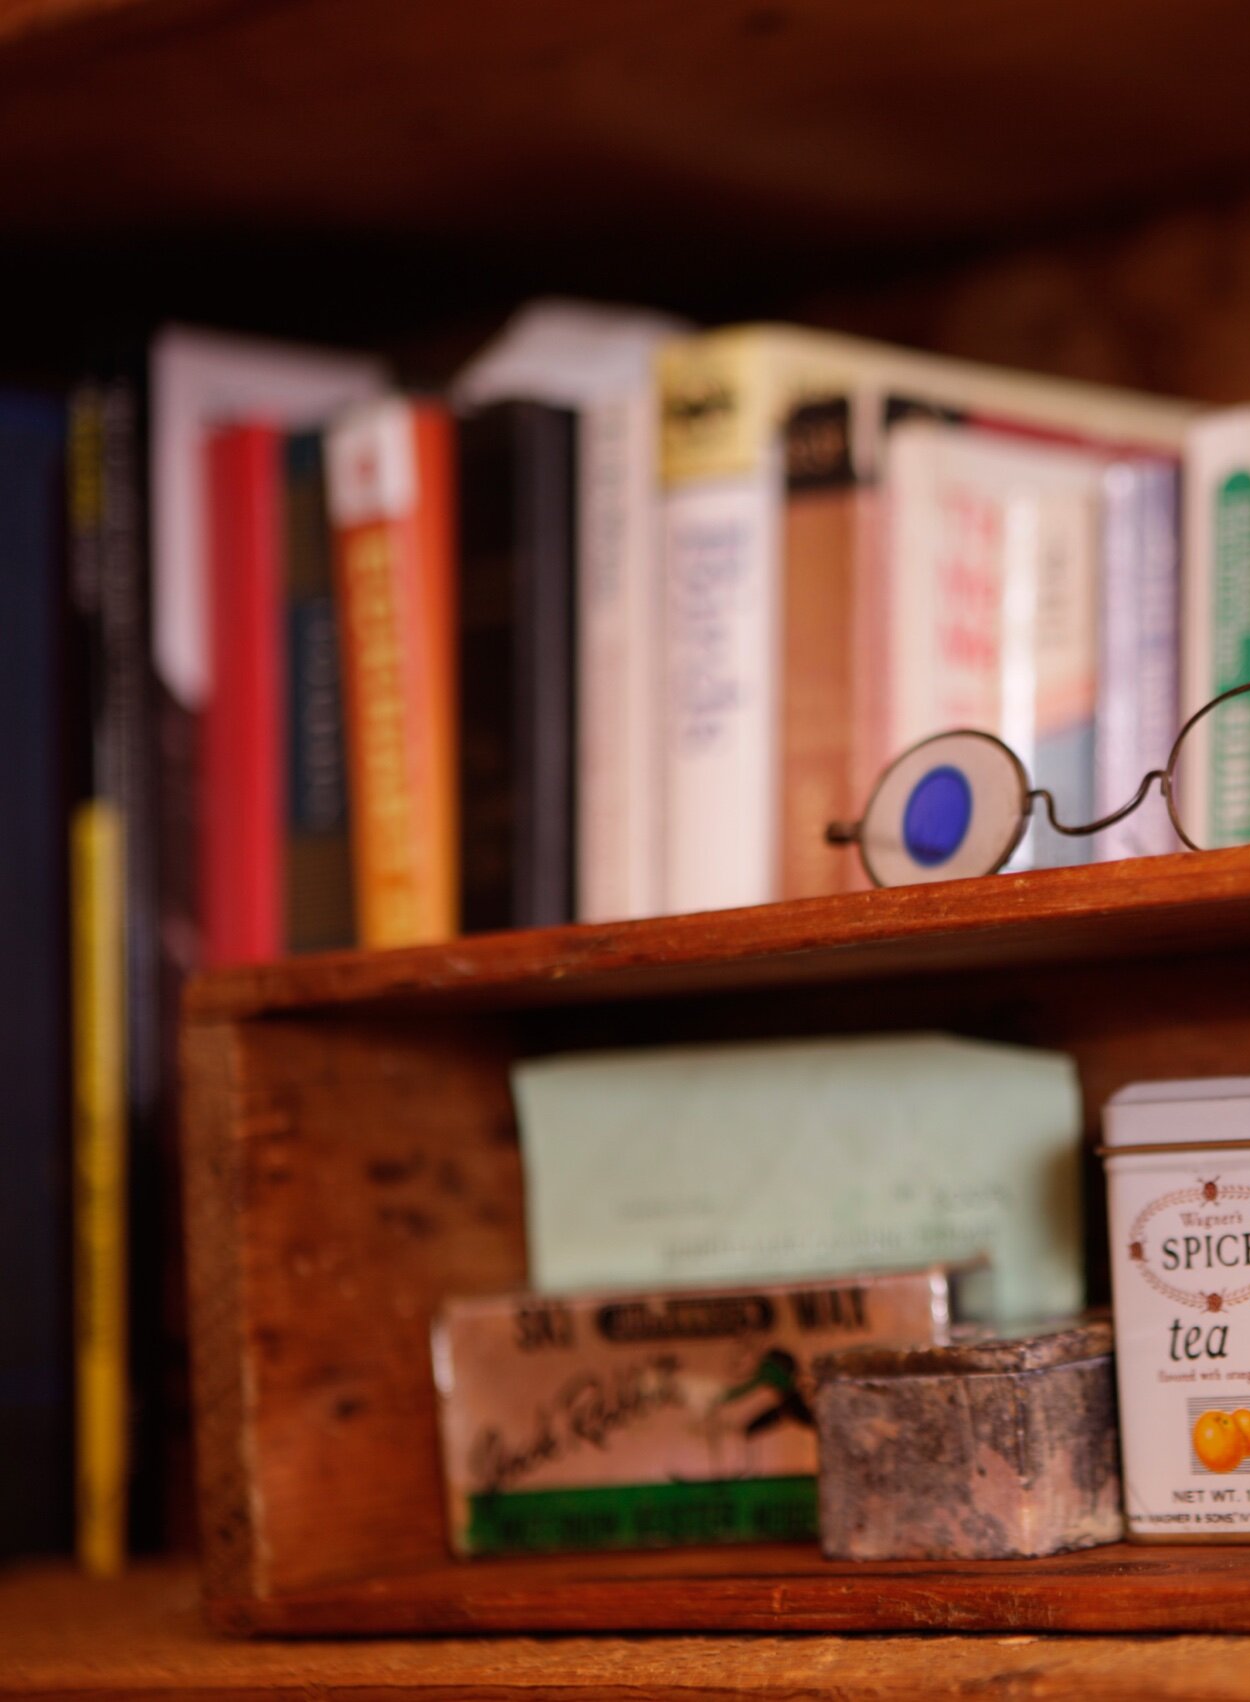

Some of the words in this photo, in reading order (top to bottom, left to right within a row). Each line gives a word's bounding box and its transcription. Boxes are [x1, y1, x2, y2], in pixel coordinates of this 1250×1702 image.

[1179, 1211, 1243, 1230] Wagner's
[1169, 1317, 1230, 1361] tea
[1171, 1489, 1205, 1503] NET
[1210, 1489, 1241, 1502] WT.
